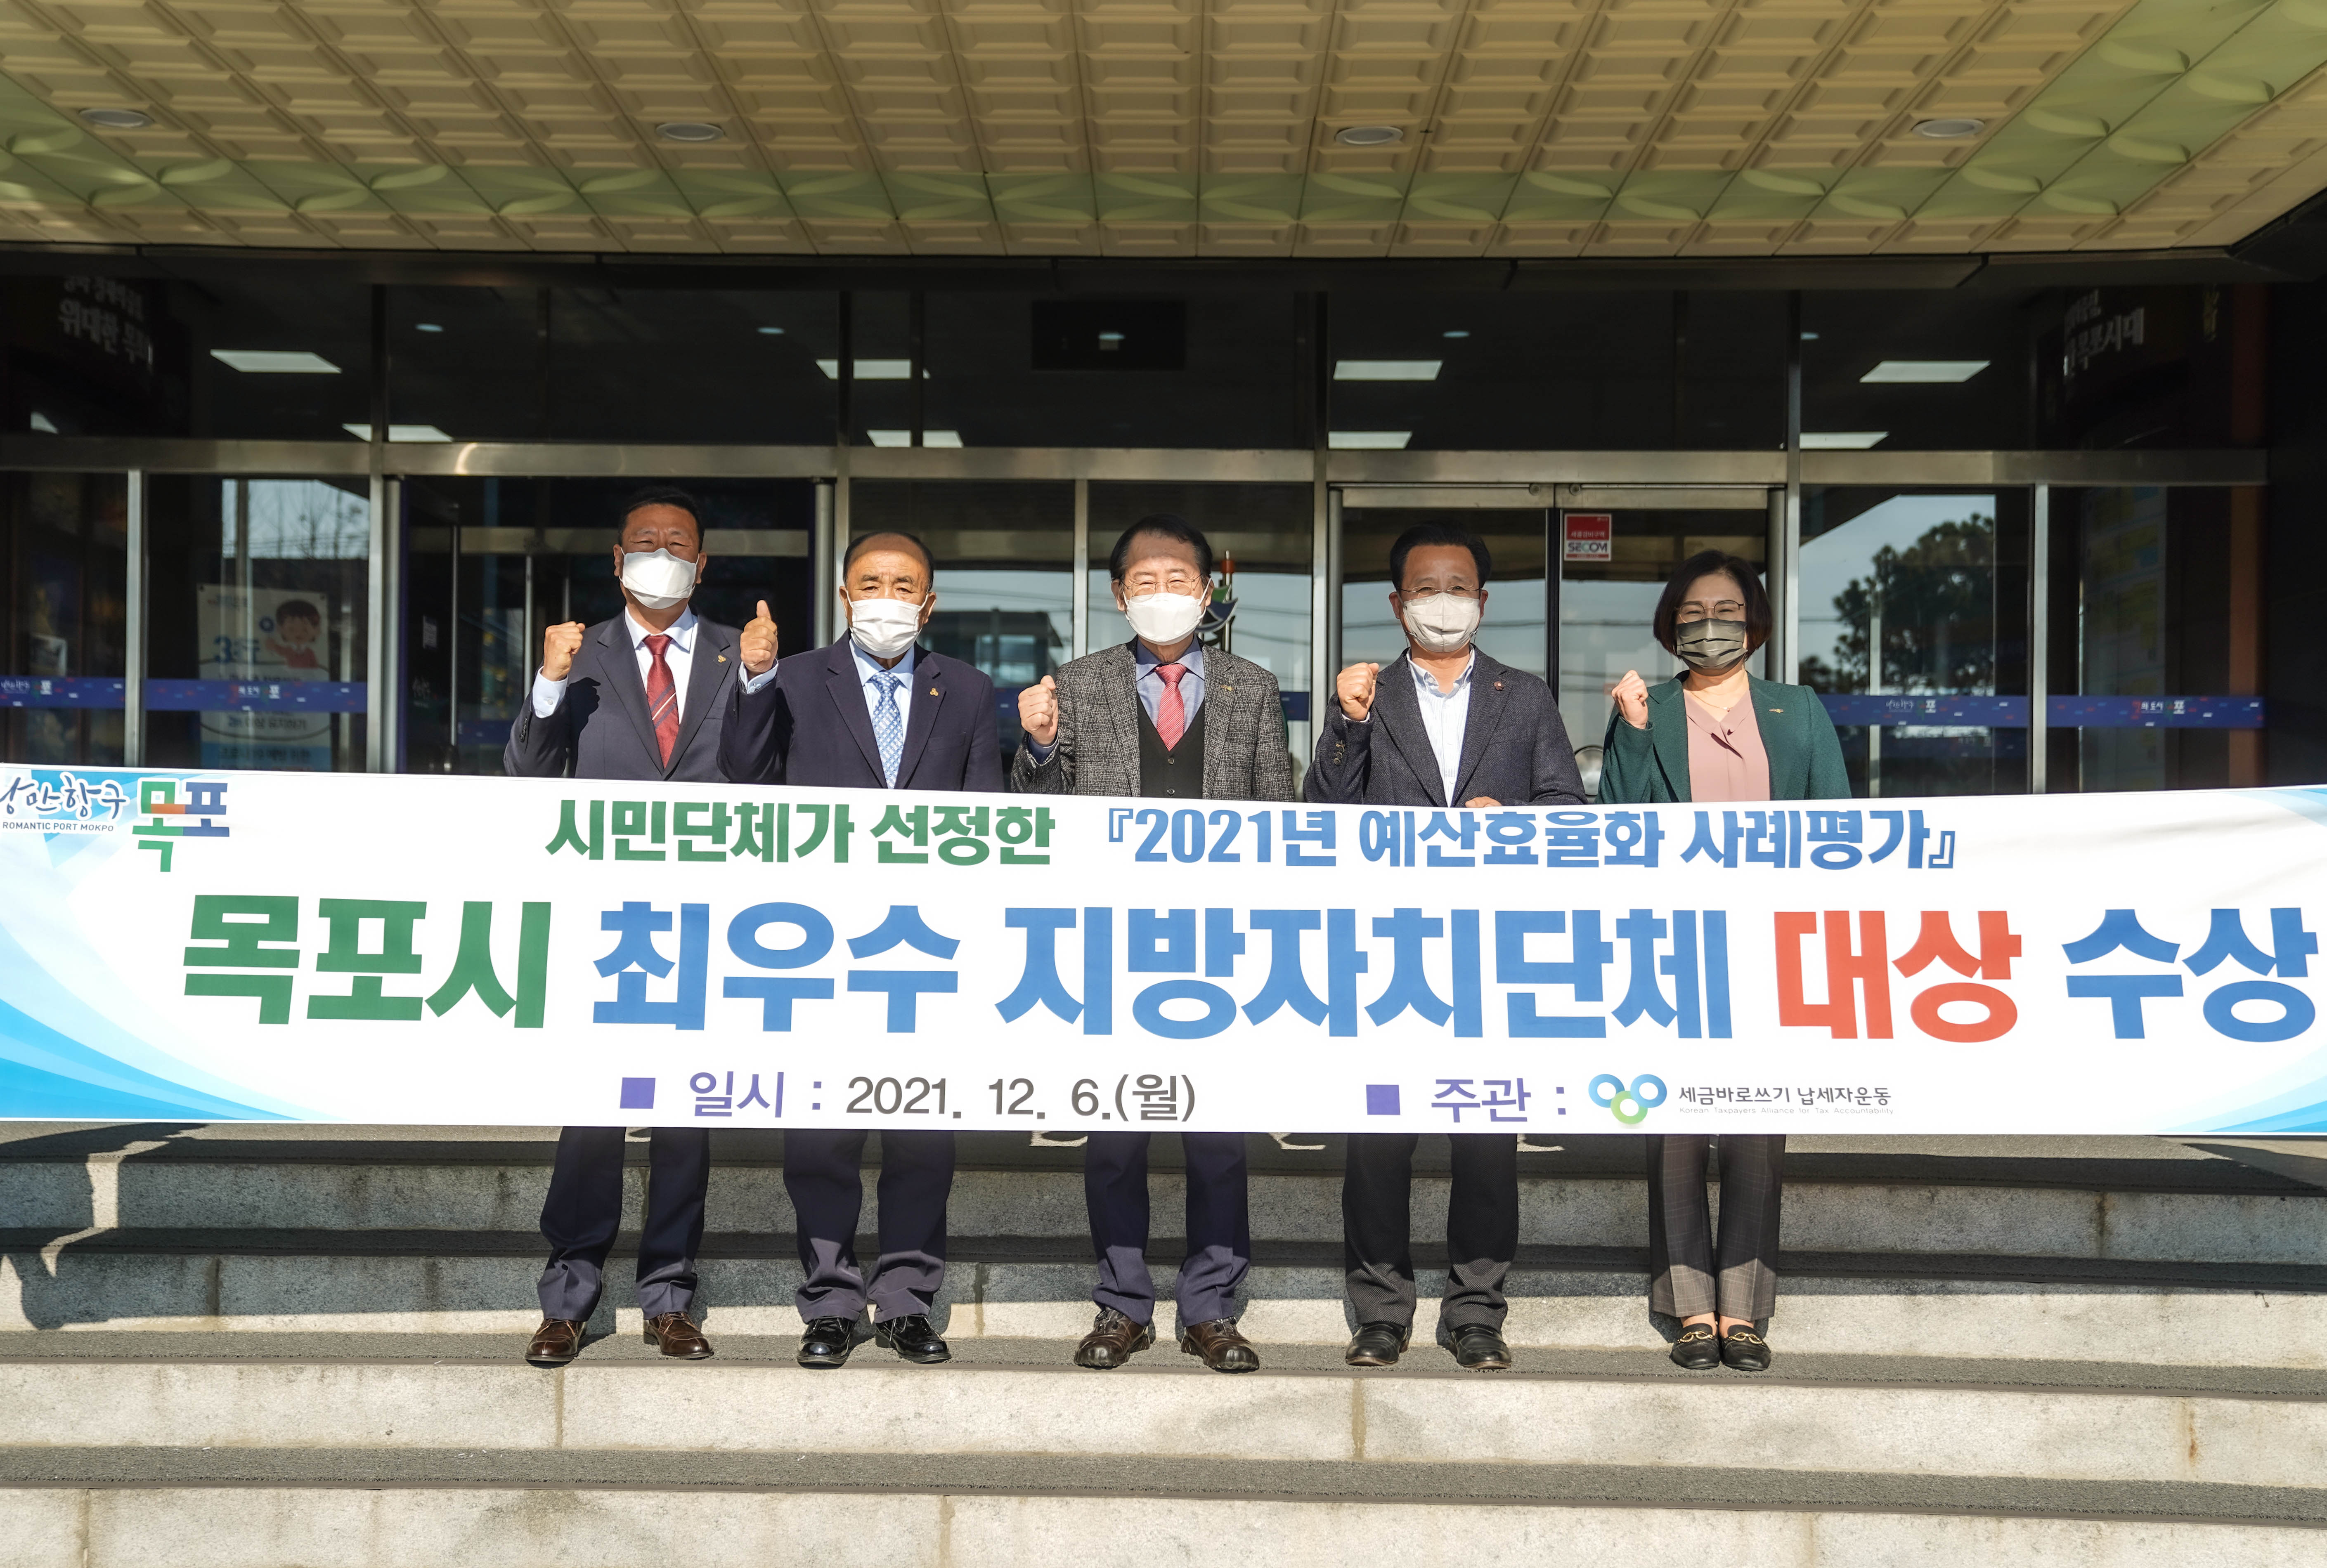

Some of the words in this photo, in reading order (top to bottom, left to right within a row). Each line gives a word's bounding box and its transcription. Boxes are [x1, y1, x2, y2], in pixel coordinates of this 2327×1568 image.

[1568, 542, 1607, 553] SECOM
[2, 822, 51, 830] ROMANTIC
[132, 781, 230, 872] 목포
[545, 800, 854, 863] 시민단체가
[870, 805, 1055, 866] 선정한
[1360, 808, 1665, 868] 예산효율화
[1680, 809, 1955, 870] 사례평가』
[183, 895, 551, 1028] 목포시
[593, 902, 960, 1032] 최우수
[995, 907, 1732, 1039] 지방자치단체
[1774, 911, 2022, 1043] 대상
[2062, 908, 2318, 1043] 수상
[690, 1072, 784, 1117] 일시
[847, 1077, 961, 1119] 2021.
[989, 1078, 1045, 1119] 12.
[1431, 1078, 1531, 1122] 주관
[1679, 1087, 1790, 1105] 세금바로쓰기
[1797, 1087, 1892, 1106] 납세자운동
